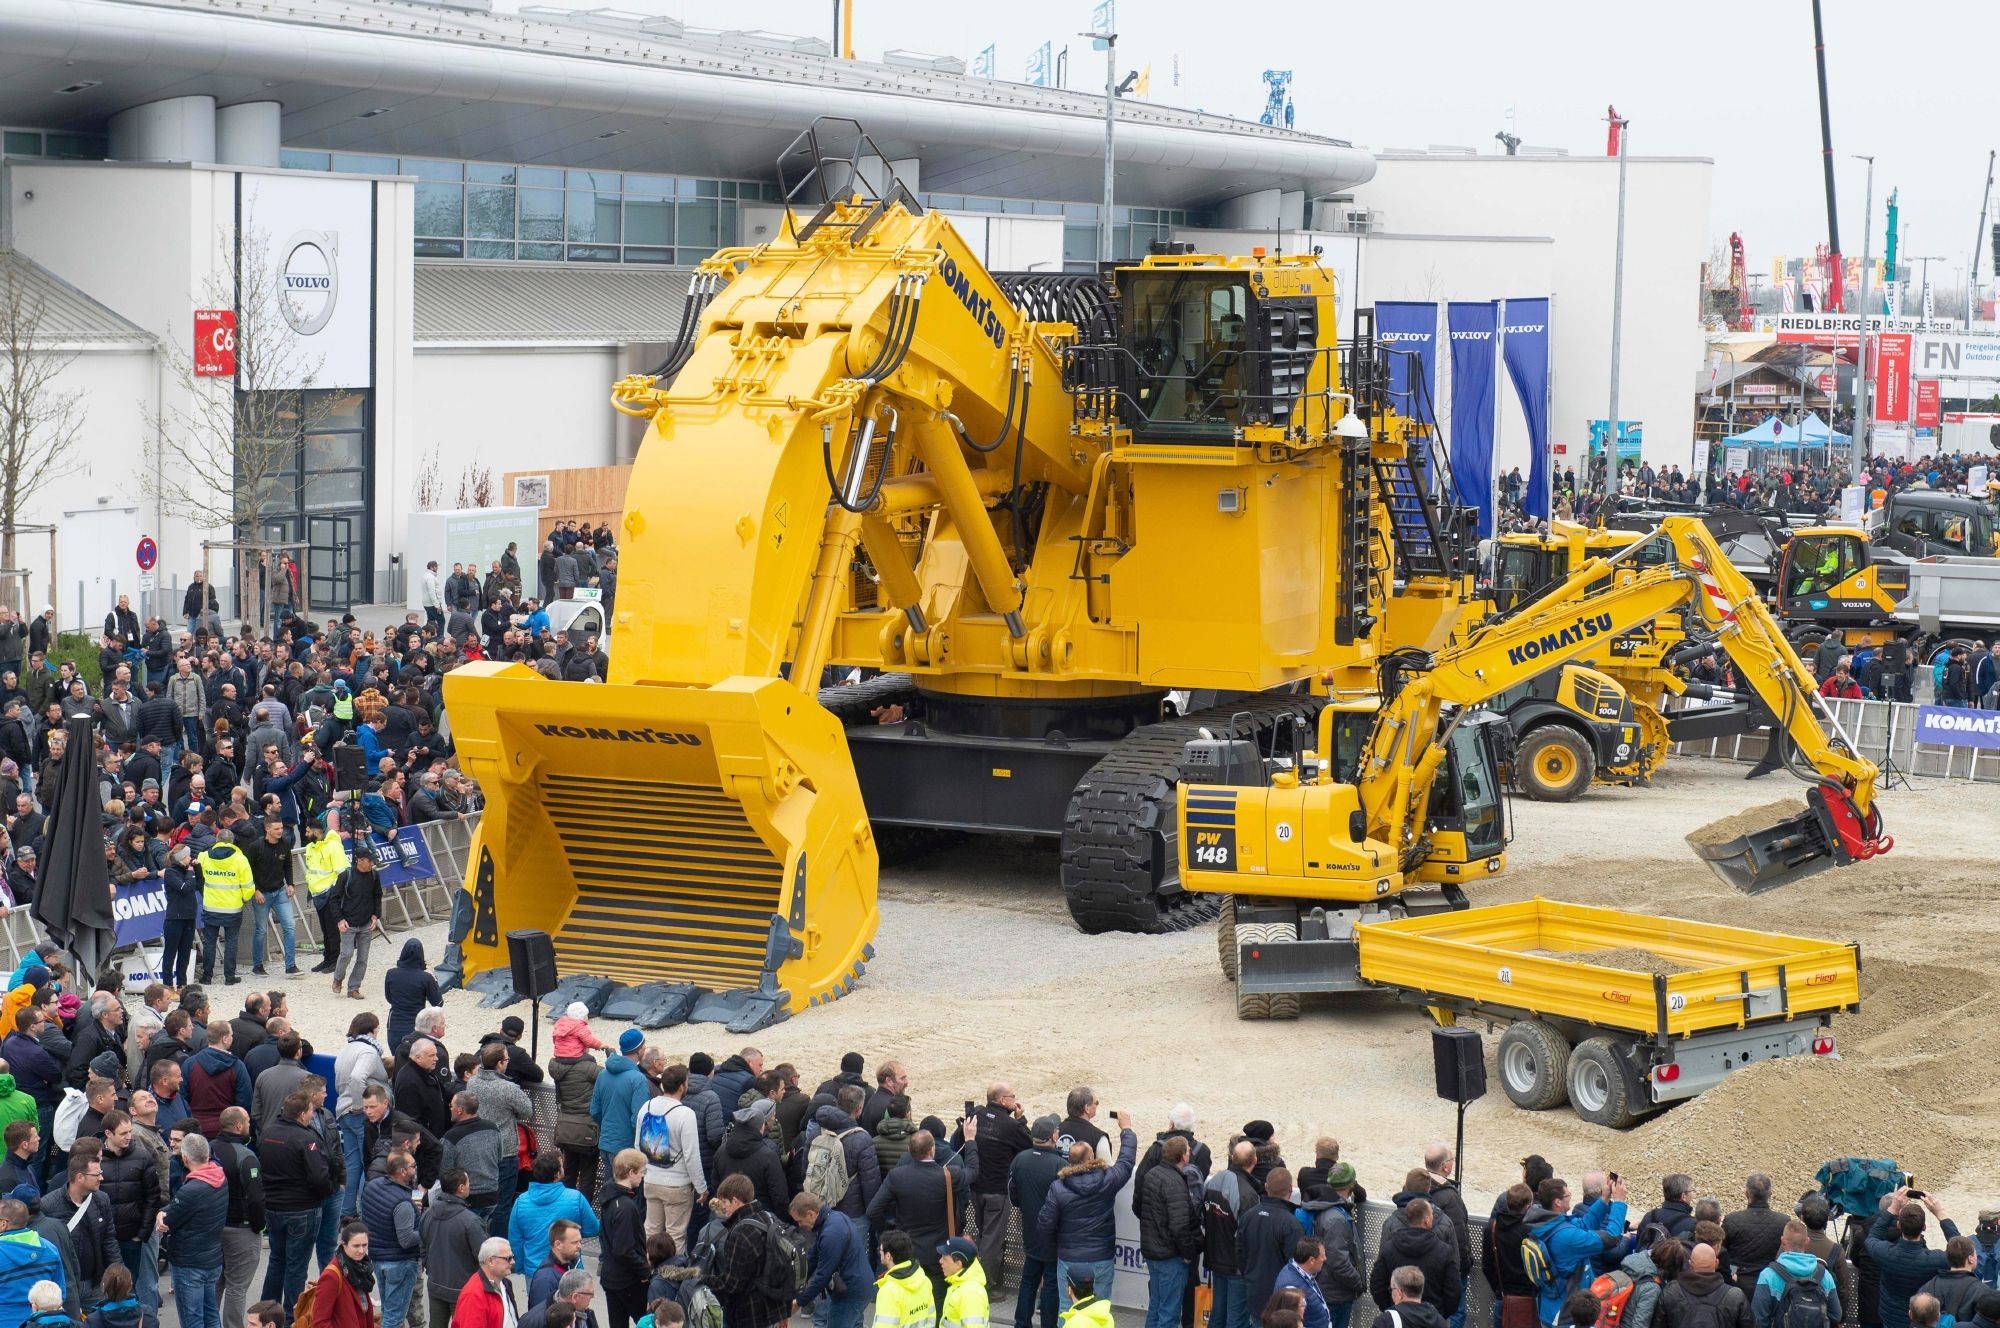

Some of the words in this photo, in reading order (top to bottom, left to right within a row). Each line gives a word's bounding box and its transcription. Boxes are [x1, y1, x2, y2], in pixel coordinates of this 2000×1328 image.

[286, 277, 329, 288] VOLVO
[933, 241, 1005, 349] KOMATSU
[1781, 318, 1881, 330] RIEDLBERGER
[213, 328, 234, 351] C6
[1924, 342, 1960, 369] FN
[1508, 613, 1613, 666] KOMATSU
[534, 724, 702, 746] KOMATSU
[1197, 832, 1221, 844] PW
[1279, 826, 1289, 838] 20
[1196, 847, 1227, 864] 148
[1326, 863, 1360, 871] KOMATSU
[1815, 972, 1837, 984] Fliegl
[1610, 991, 1631, 1003] Fliegl
[1671, 997, 1683, 1010] 20
